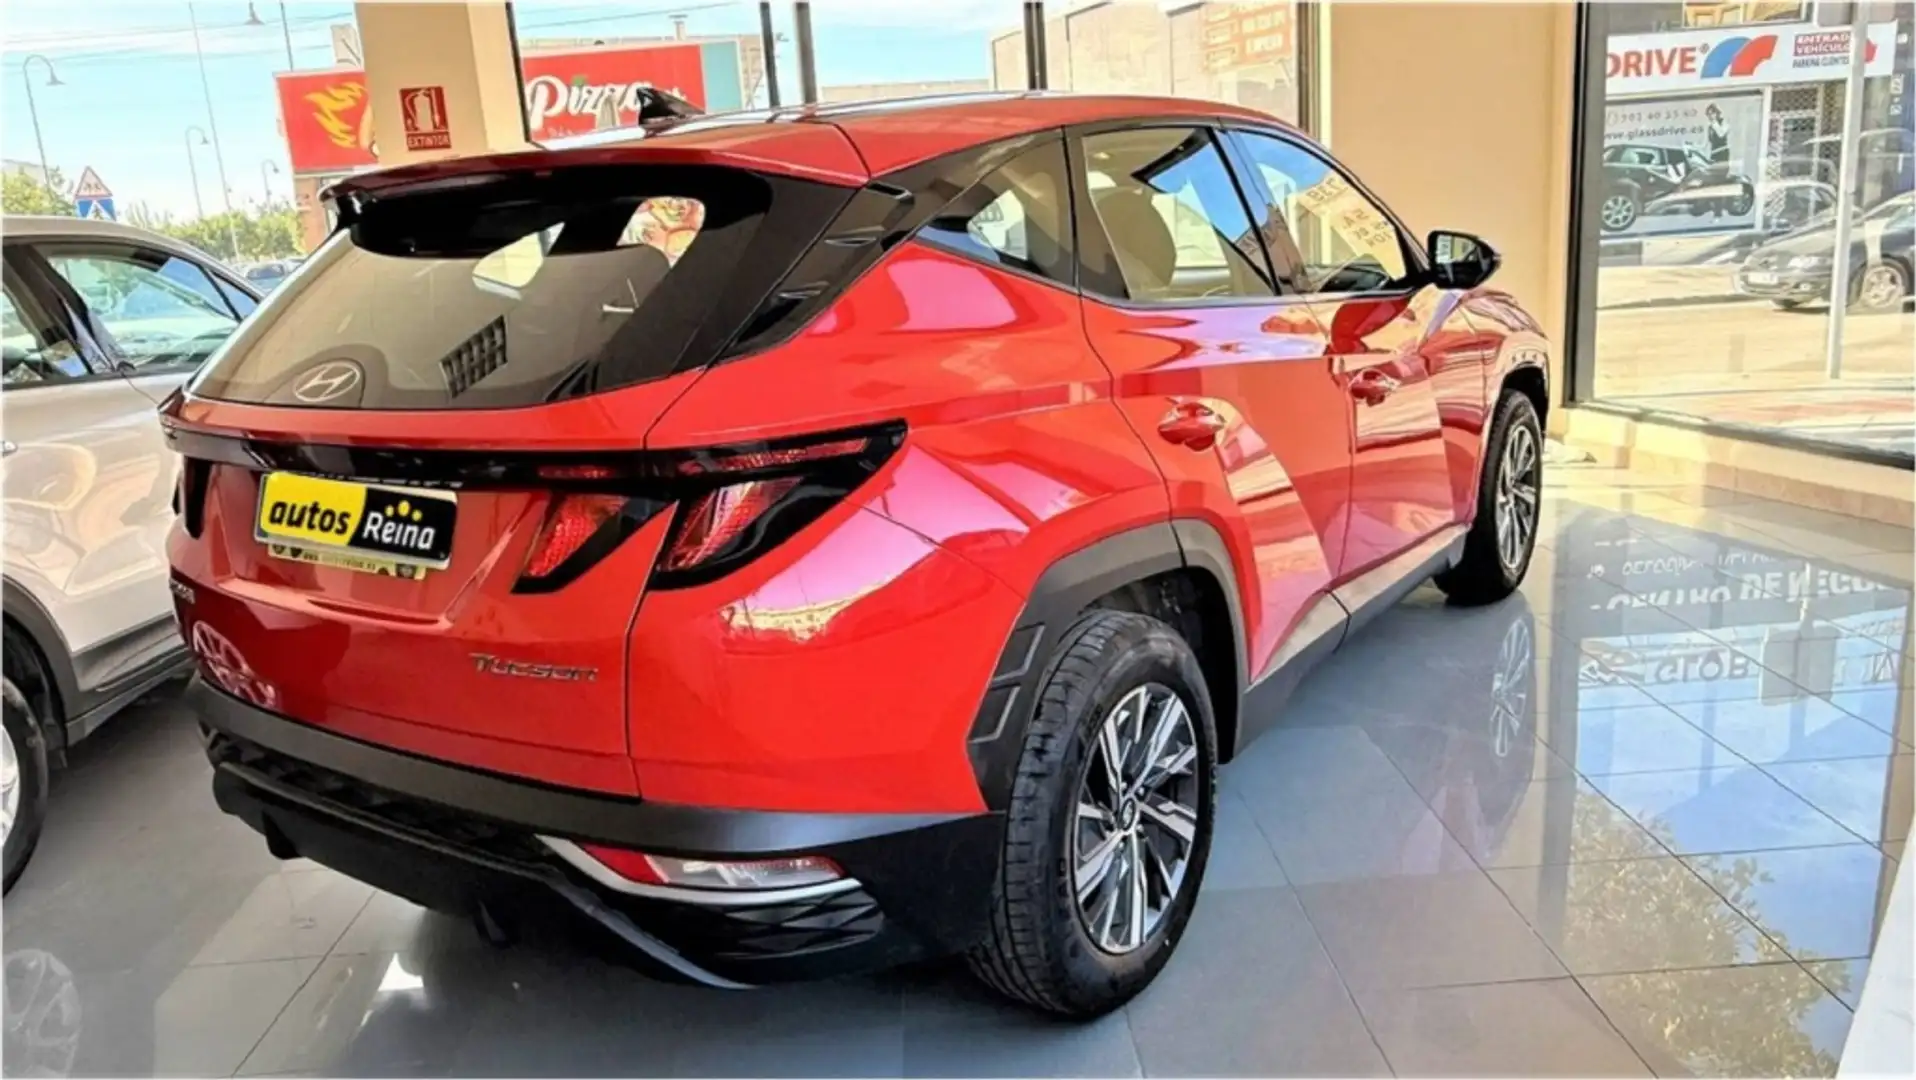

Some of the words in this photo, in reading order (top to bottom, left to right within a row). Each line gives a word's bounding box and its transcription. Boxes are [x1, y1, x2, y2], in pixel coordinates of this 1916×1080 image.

[1797, 34, 1850, 44] ENTRAD
[408, 134, 450, 148] EXTINTOR
[269, 500, 351, 535] autos
[362, 511, 436, 550] Reina
